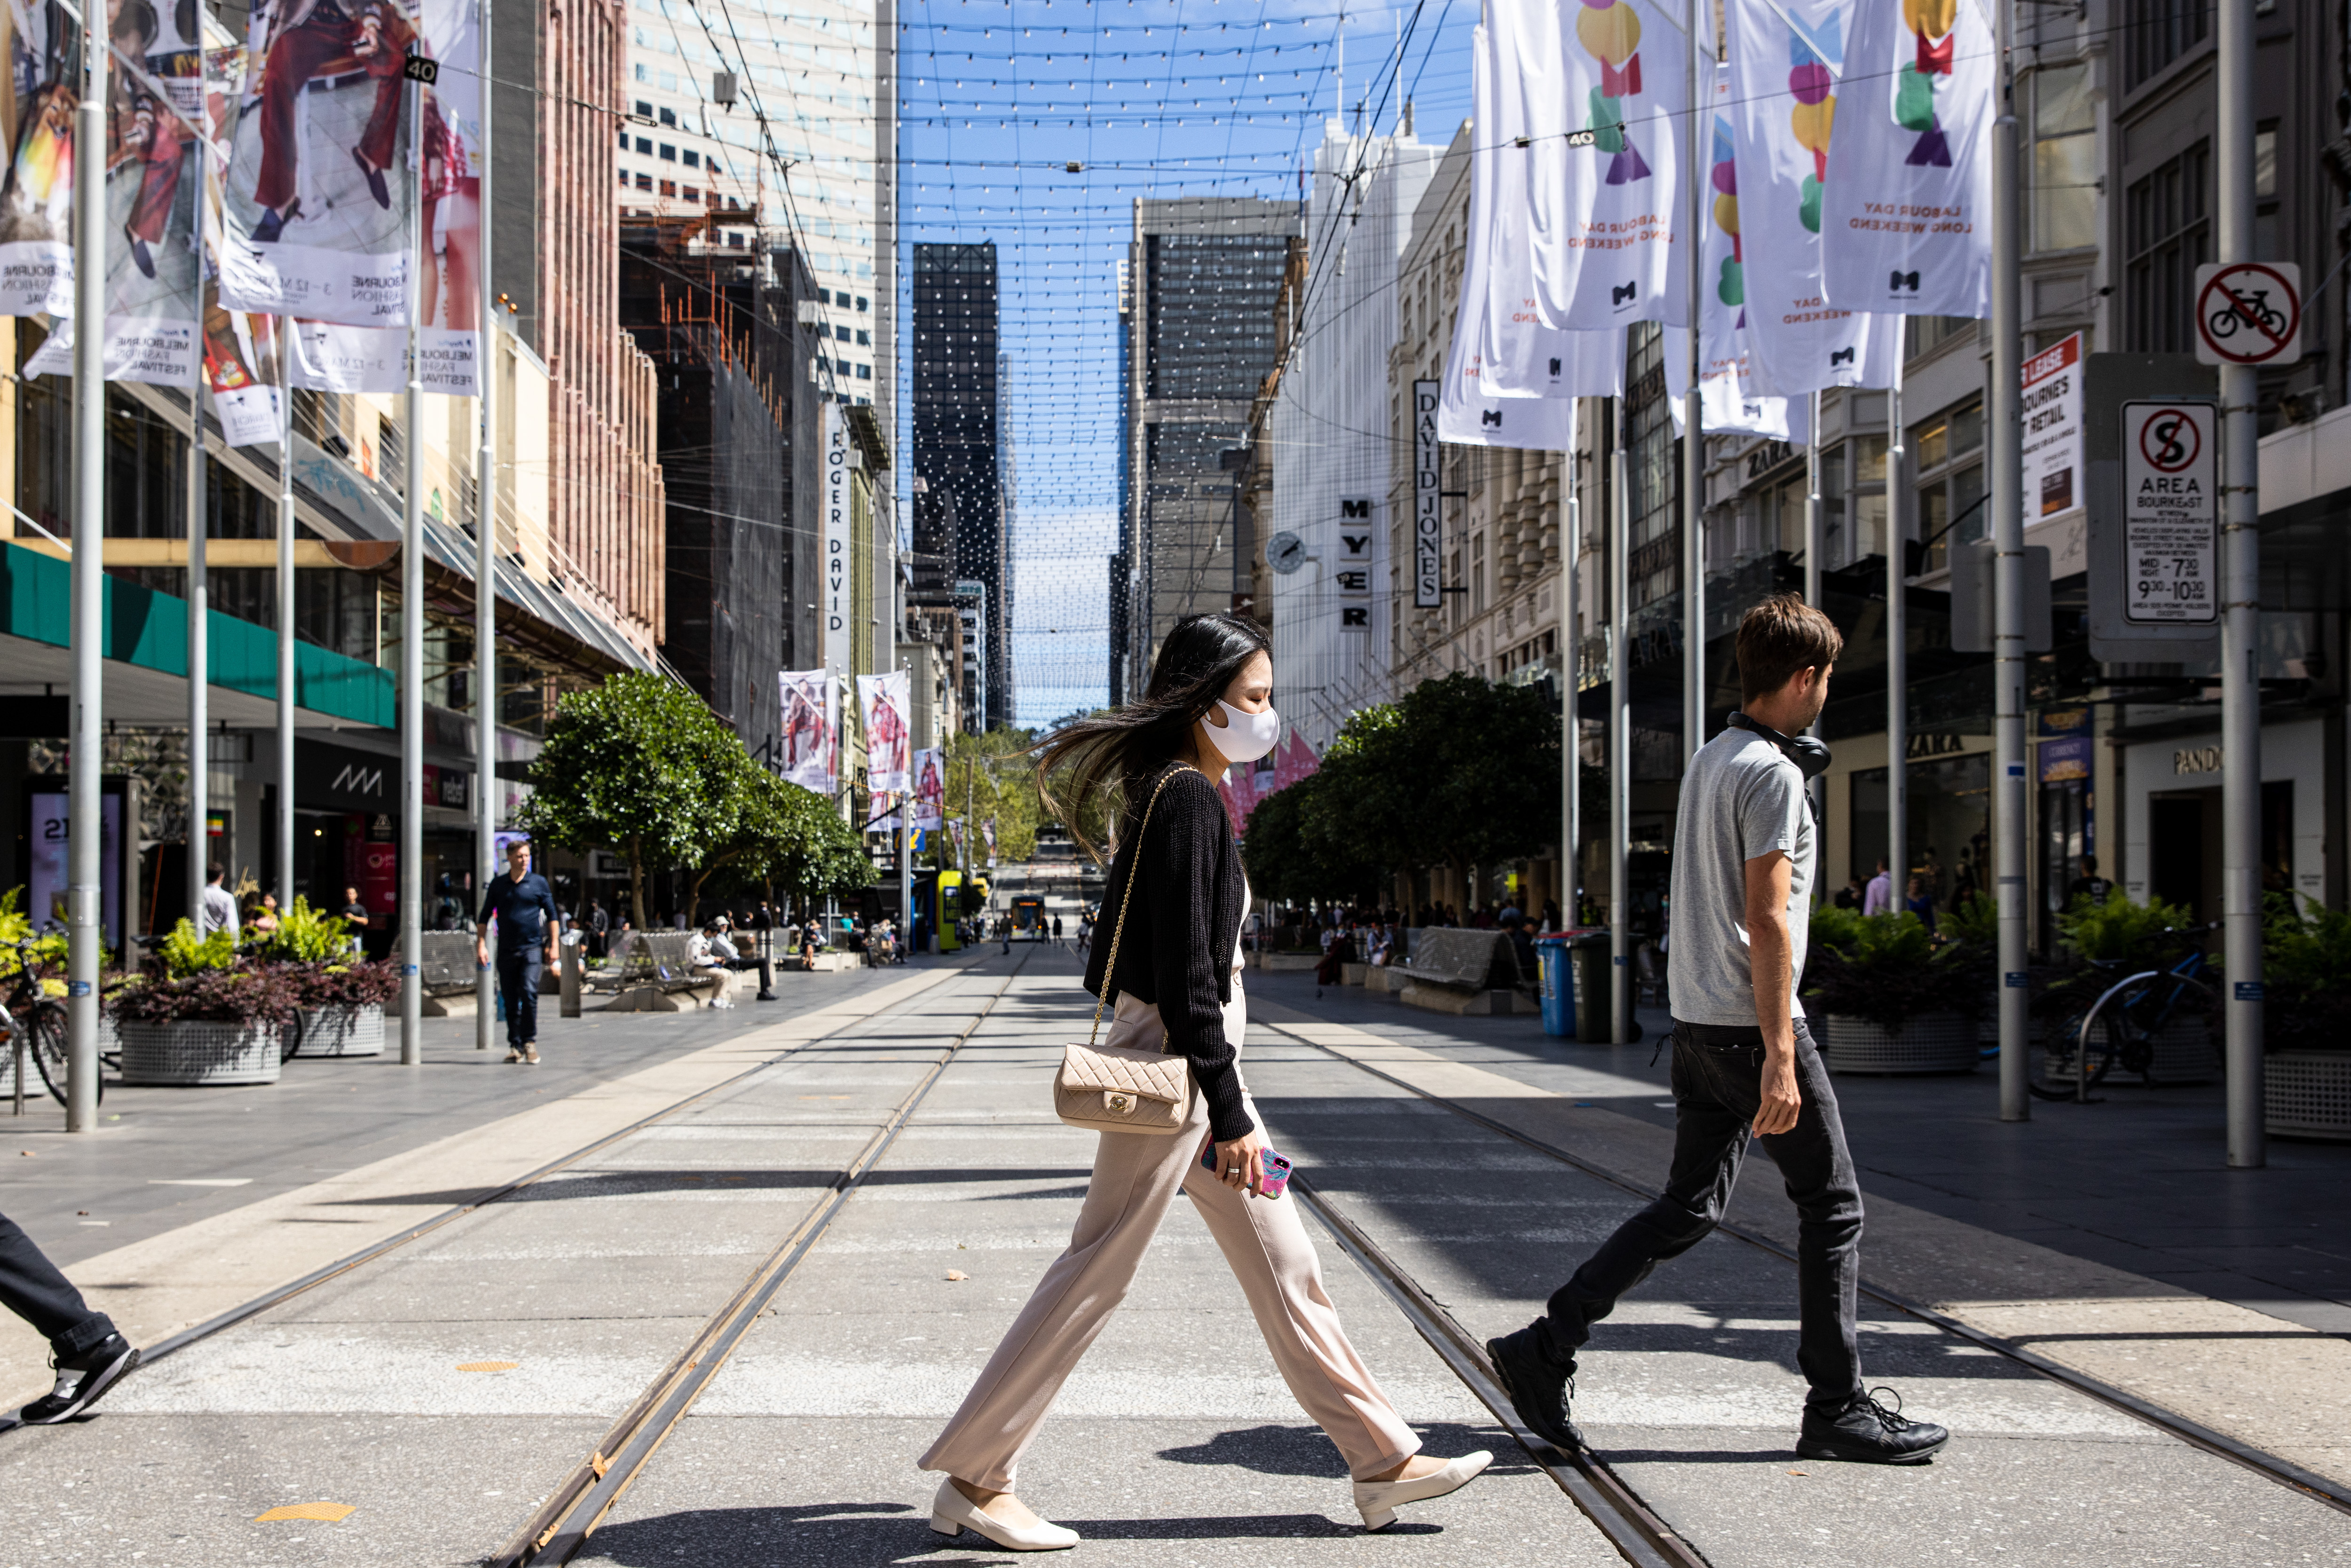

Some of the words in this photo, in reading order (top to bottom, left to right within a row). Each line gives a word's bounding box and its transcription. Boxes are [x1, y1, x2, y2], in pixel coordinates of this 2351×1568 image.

[408, 61, 436, 81] 40
[1570, 132, 1594, 145] 40
[2029, 346, 2064, 382] LEASE
[2030, 403, 2065, 435] RETAIL
[1419, 394, 1437, 489] DAVID
[1747, 440, 1793, 479] ZARA
[2154, 421, 2185, 463] S
[829, 433, 843, 523] ROGER
[2140, 477, 2201, 494] AREA
[2137, 496, 2184, 508] BOURKE
[2187, 496, 2202, 508] ST
[1341, 500, 1369, 626] MYER
[1419, 496, 1437, 597] JONES
[2139, 558, 2160, 568] MID
[830, 540, 843, 630] DAVID
